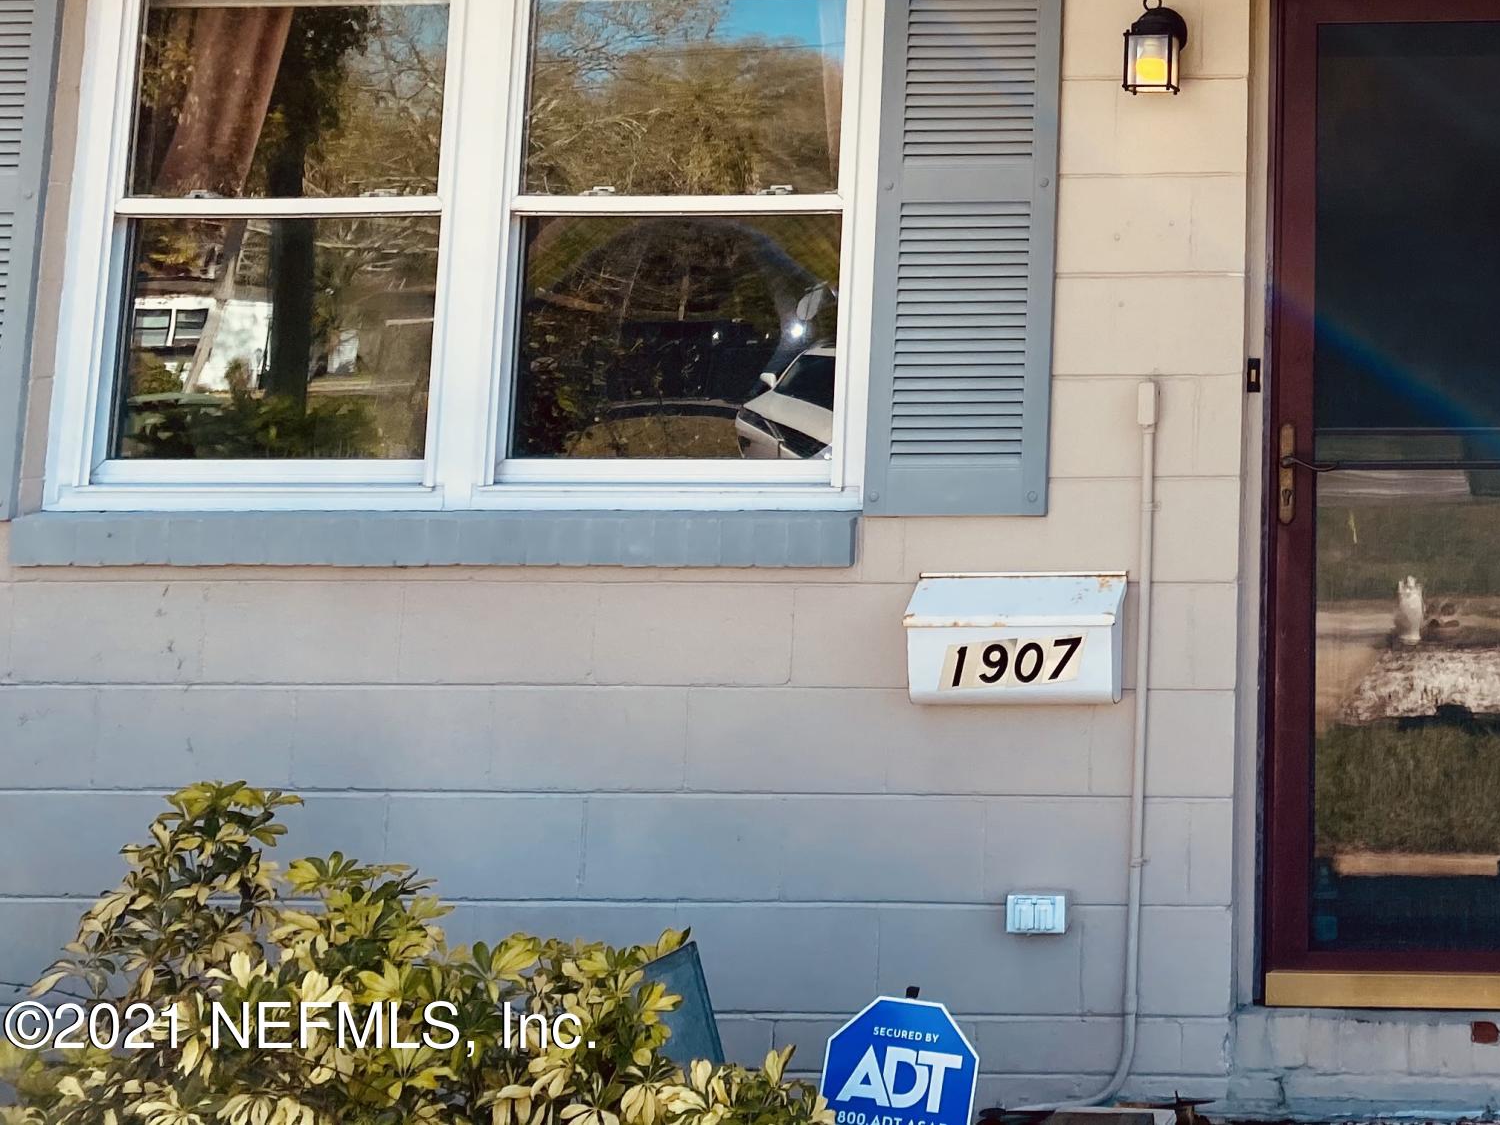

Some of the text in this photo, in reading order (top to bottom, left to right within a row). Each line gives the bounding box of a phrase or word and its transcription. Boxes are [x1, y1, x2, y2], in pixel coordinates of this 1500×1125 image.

[952, 636, 1082, 687] 1907
[873, 1026, 939, 1043] SECURED BY
[835, 1044, 963, 1113] ADT
